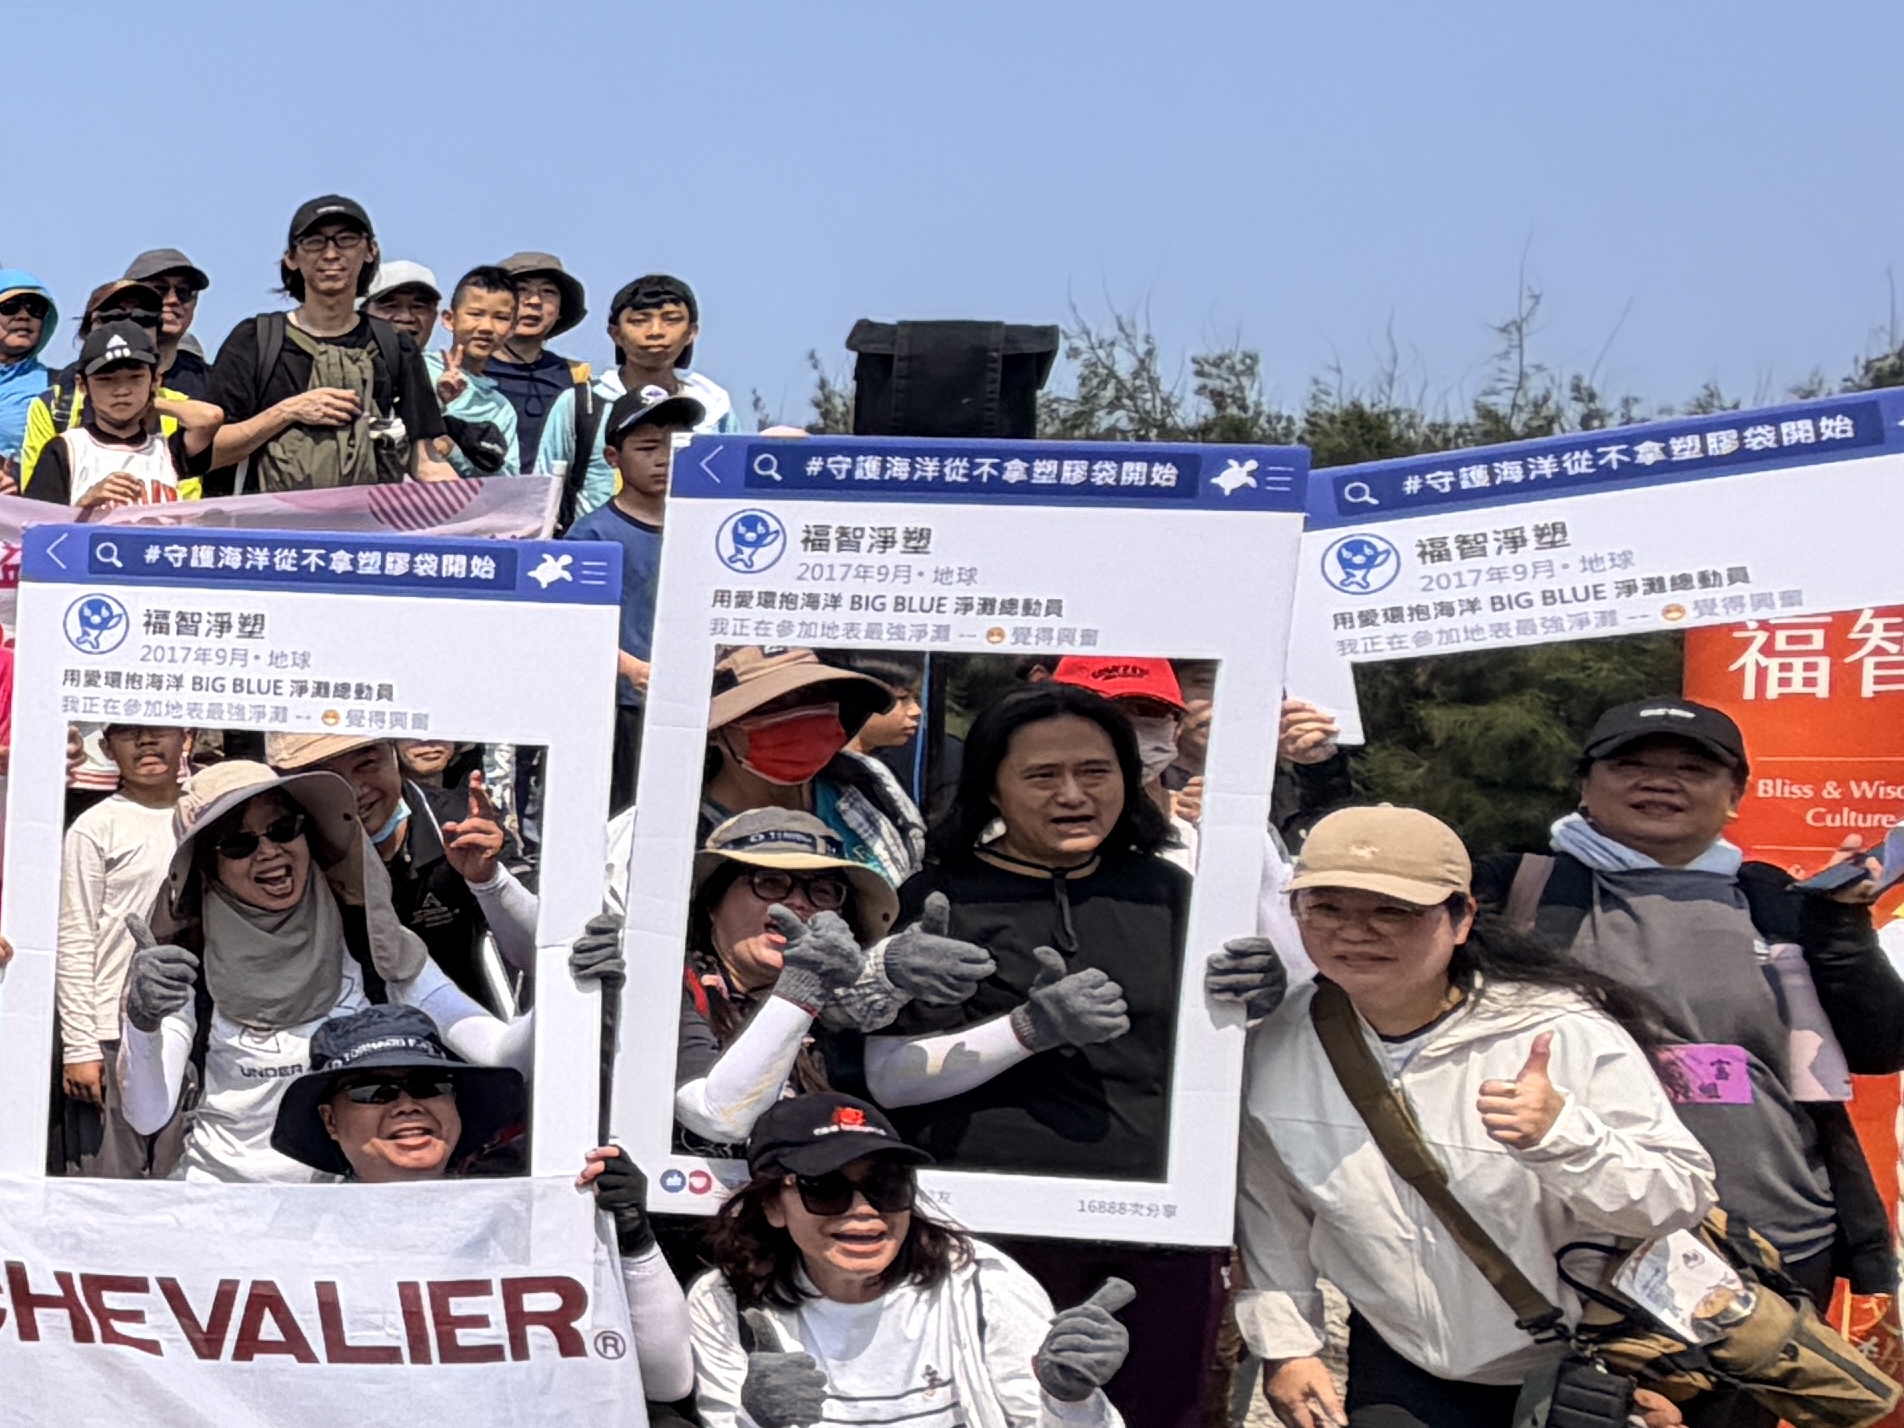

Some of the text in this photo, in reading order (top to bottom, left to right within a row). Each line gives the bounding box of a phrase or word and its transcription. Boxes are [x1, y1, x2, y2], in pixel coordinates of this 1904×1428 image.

[804, 455, 1180, 487] #守護海洋從不拿塑膠袋開始
[1401, 414, 1856, 496] #守護海洋從不拿塑膠袋開始
[800, 524, 933, 556] 福智淨塑
[1414, 520, 1571, 566] 福智淨塑
[144, 544, 497, 580] #守護海洋從不拿塑膠袋開始
[711, 590, 842, 610] 用愛環抱海洋
[850, 594, 886, 613] BIG
[893, 595, 947, 615] BLUE
[1332, 598, 1483, 630] 用愛環抱海洋
[1490, 588, 1534, 613] BIG
[1541, 582, 1607, 607] BLUE
[141, 608, 266, 640] 福智淨塑
[62, 669, 183, 693] 用愛環抱海洋
[192, 674, 227, 694] BIG
[233, 675, 283, 697] BLUE
[1757, 779, 1814, 799] Bliss
[1822, 781, 1842, 799] &
[1805, 807, 1898, 828] Culture
[241, 1064, 303, 1078] UNDER
